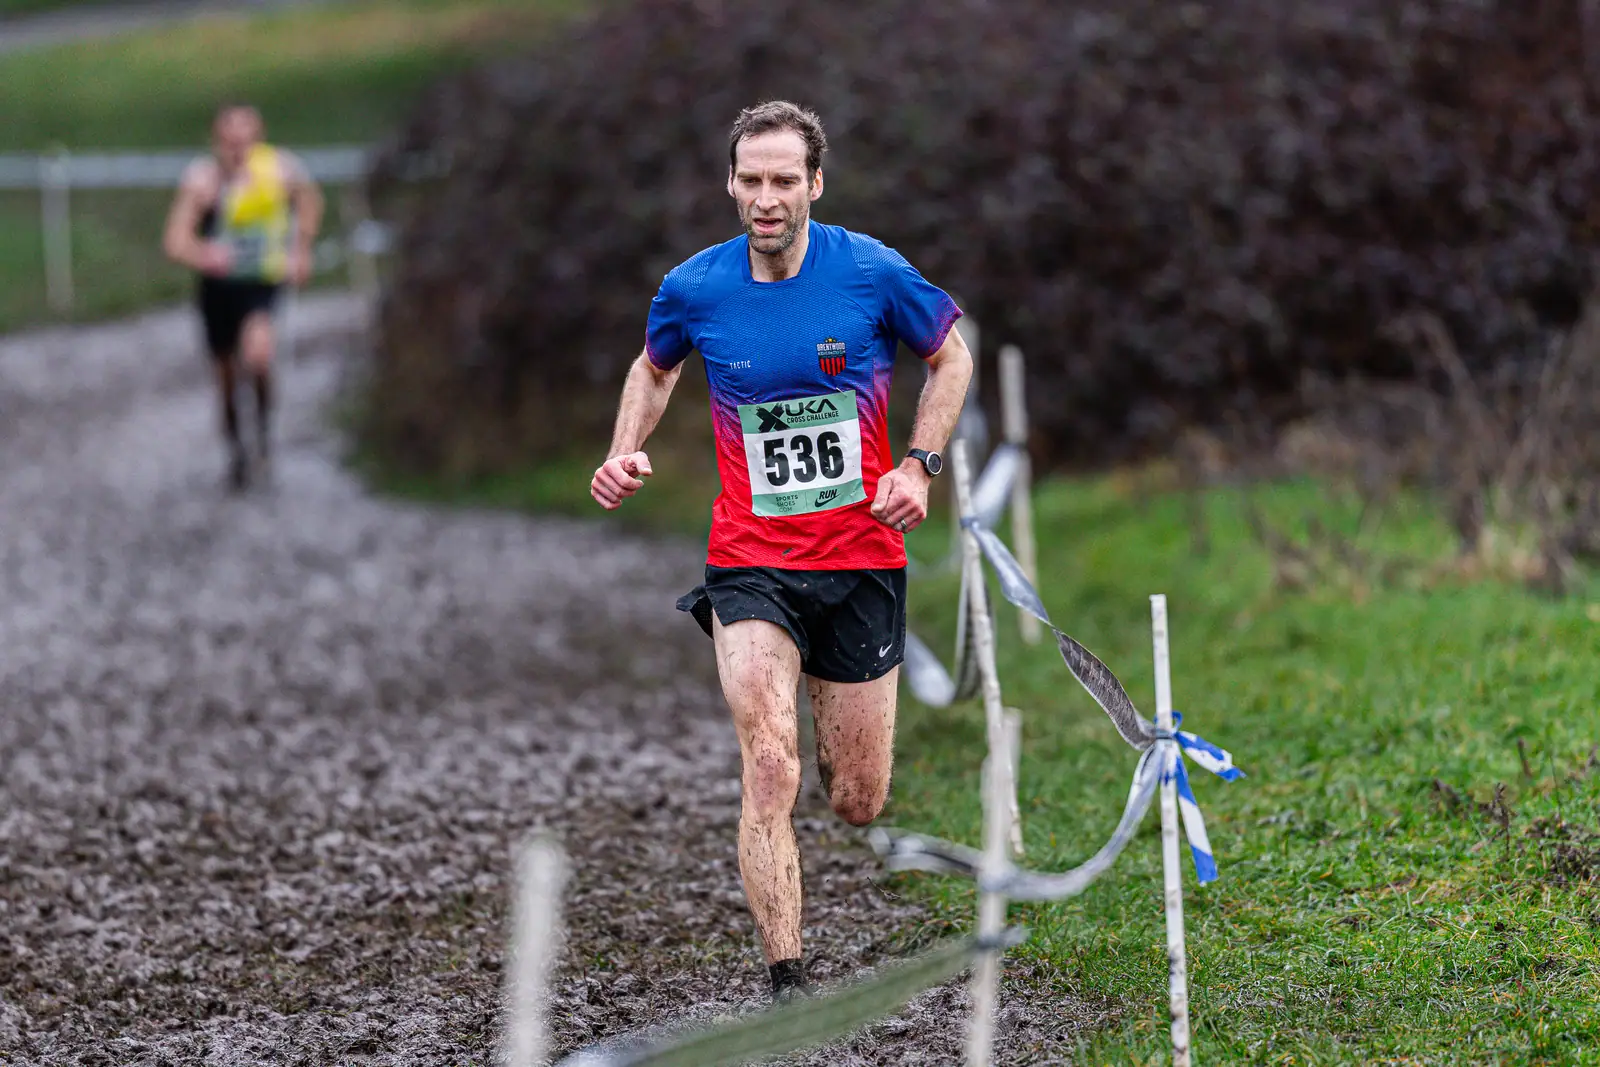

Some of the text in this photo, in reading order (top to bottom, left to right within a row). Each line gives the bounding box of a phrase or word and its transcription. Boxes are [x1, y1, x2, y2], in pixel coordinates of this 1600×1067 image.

[729, 360, 752, 370] TACTIC
[785, 398, 838, 416] UKA
[786, 411, 839, 424] CROSS CHALLENGE
[763, 431, 845, 487] 536
[775, 494, 799, 502] SPORTS
[818, 488, 838, 500] RUN
